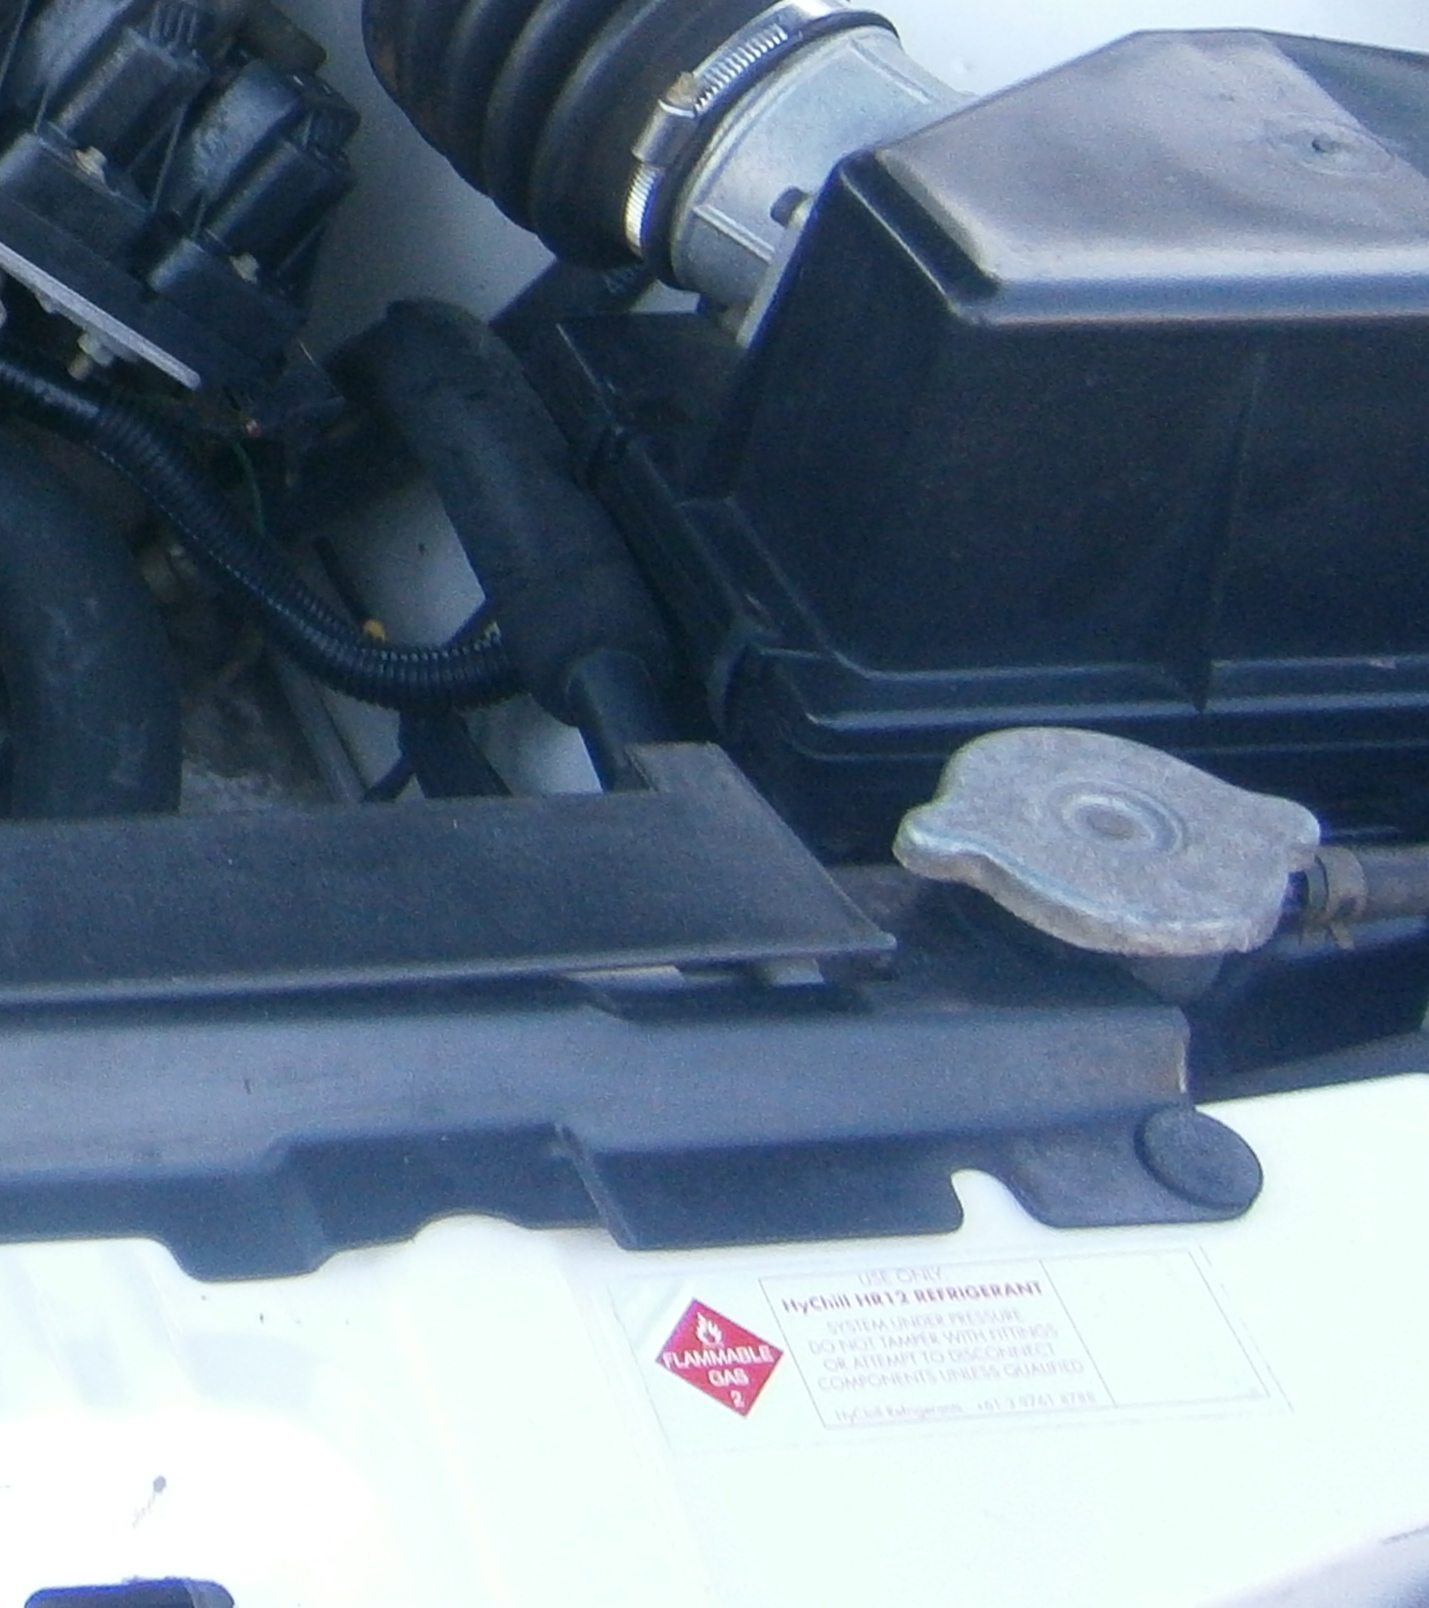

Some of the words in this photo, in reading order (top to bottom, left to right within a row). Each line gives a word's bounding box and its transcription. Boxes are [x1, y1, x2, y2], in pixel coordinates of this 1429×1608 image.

[781, 1294, 851, 1315] HyChill
[857, 1291, 910, 1308] HR12
[913, 1280, 1042, 1304] REFRIGERANT
[662, 1345, 774, 1369] FLAMMABLE
[708, 1368, 749, 1387] GAS
[730, 1390, 745, 1408] 2
